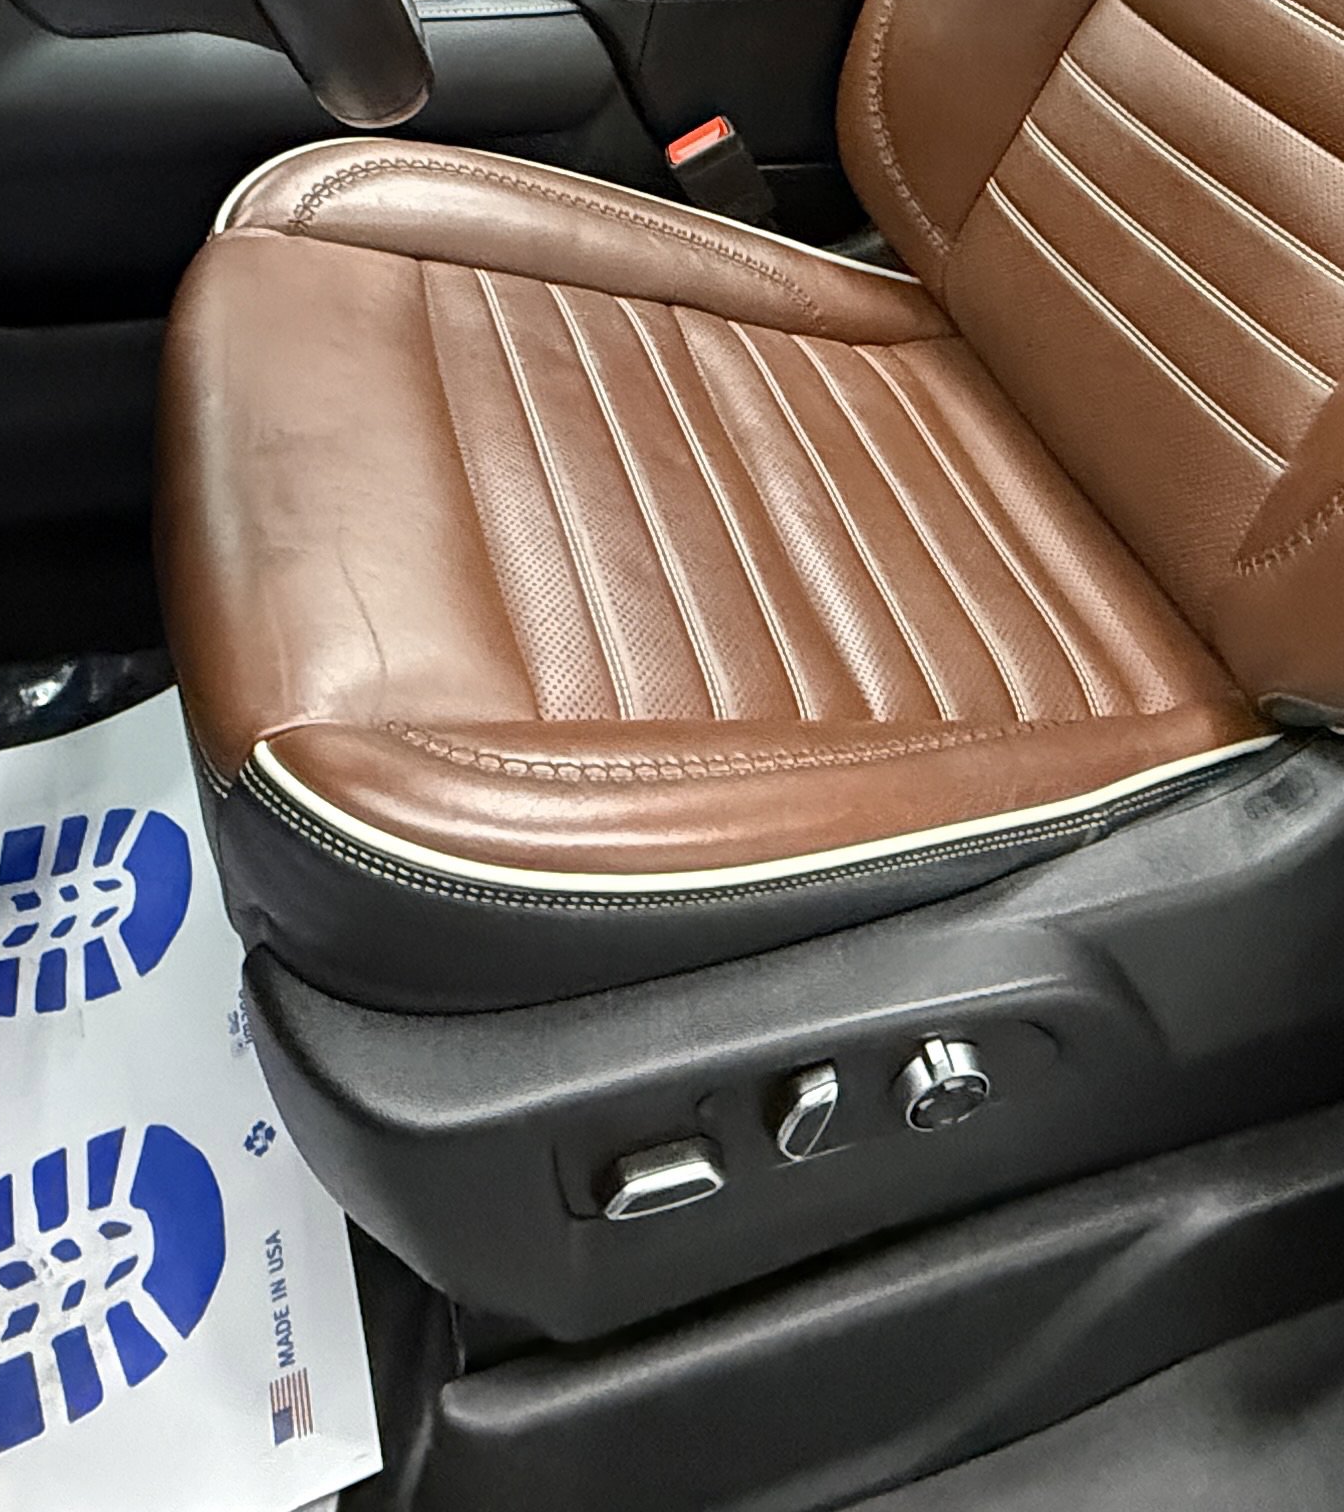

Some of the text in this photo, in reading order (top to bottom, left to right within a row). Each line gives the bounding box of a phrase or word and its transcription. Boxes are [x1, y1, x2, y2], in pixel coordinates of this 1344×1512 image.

[264, 1229, 296, 1368] MADE IN USA
